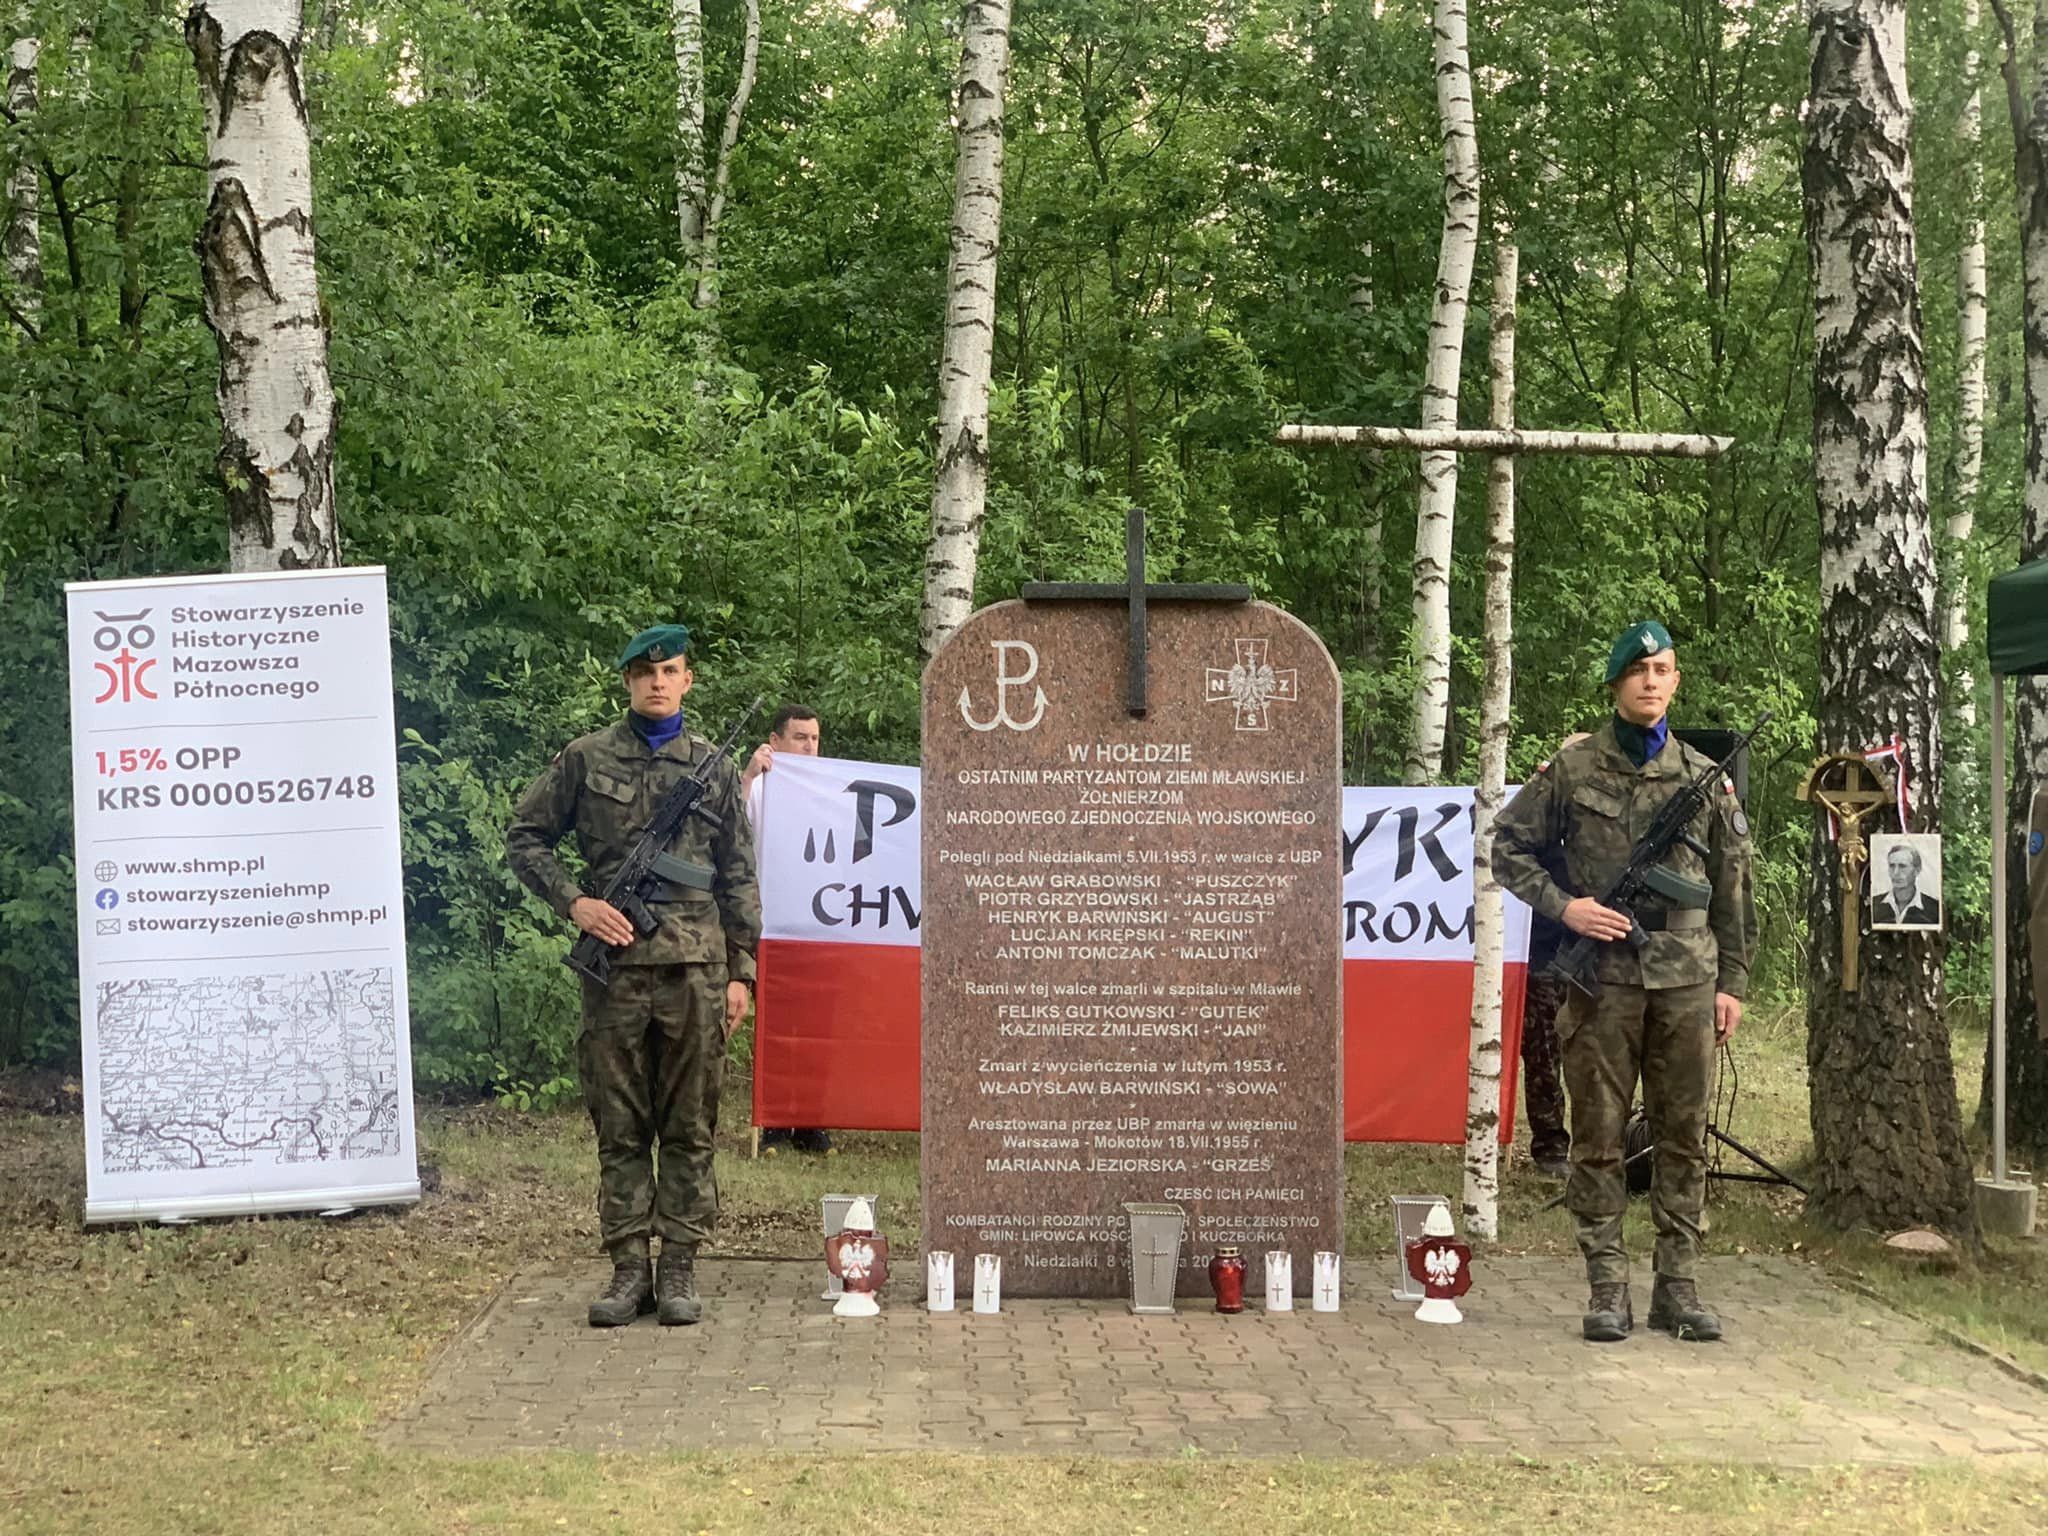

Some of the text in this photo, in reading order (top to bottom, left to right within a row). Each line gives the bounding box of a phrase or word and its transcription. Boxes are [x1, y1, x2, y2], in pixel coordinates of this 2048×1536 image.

[171, 597, 365, 624] Stowarzyszenie
[172, 627, 320, 650] Historyczne
[172, 654, 300, 673] Mazowsza
[173, 679, 320, 700] Północnego
[1211, 679, 1289, 691] N Z
[1247, 713, 1257, 725] S
[95, 746, 241, 777] 1,5% OPP
[1068, 744, 1192, 763] W HOŁDZIE
[958, 770, 1305, 785] OSTATNIM PARTYZANTOM ZIEMI MŁAWSKIEJ
[97, 775, 376, 811] KRS 0000526748
[1080, 787, 1184, 804] ŻOŁNIERZOM
[947, 810, 1316, 825] NARODOWEGO ZJEDNOCZENIA WOJSKOWEGO
[125, 856, 266, 876] www.shmp.pl
[940, 850, 1322, 866] Polegli pod Niedziałkami 5.VII.1953 r. w walce z UBP
[964, 874, 1045, 888] WACŁAW
[1050, 874, 1161, 888] GRABOWSKI
[126, 881, 331, 907] stowarzyszeniehmp
[978, 892, 1032, 906] PIOTR
[1037, 892, 1158, 906] GRZYBOWSKI
[127, 905, 388, 935] stowarzyszenie@shmp.pl
[988, 910, 1062, 924] HENRYK
[1067, 908, 1168, 924] BARWIŃSKI
[1011, 928, 1081, 942] LUCJAN
[1087, 928, 1165, 945] KRĘPSKI
[996, 946, 1062, 960] ANTONI
[1068, 946, 1156, 960] TOMCZAK
[965, 981, 1302, 999] Ranni w tej walce zmarli w szpitalu w Mławie
[998, 1005, 1060, 1019] FELIKS
[1065, 1005, 1175, 1019] GUTKOWSKI
[1000, 1023, 1096, 1037] KAZIMIERZ
[1101, 1021, 1199, 1037] ŻMIJEWSKI
[978, 1058, 1287, 1076] Zmarł z wycieńczenia w lutym 1953 r.
[979, 1081, 1095, 1095] WŁADYSŁAW
[1099, 1079, 1201, 1095] BARWIŃSKI
[968, 1117, 1298, 1134] Aresztowana przez UBP zmarła w więzieniu
[1003, 1135, 1079, 1149] Warszawa
[1094, 1135, 1163, 1149] Mokotów
[1168, 1135, 1249, 1149] 18.VII.1955
[1253, 1139, 1264, 1149] r.
[986, 1158, 1081, 1172] MARIANNA
[1086, 1158, 1187, 1172] JEZIORSKA
[1216, 1187, 1241, 1201] ICH
[945, 1215, 1036, 1226] KOMBATANCI
[1042, 1215, 1103, 1227] RODZINY
[979, 1230, 1019, 1242] GMIN:
[1022, 1230, 1086, 1242] LIPOWCA
[1024, 1254, 1098, 1268] Niedziałki
[1106, 1255, 1116, 1268] 8
